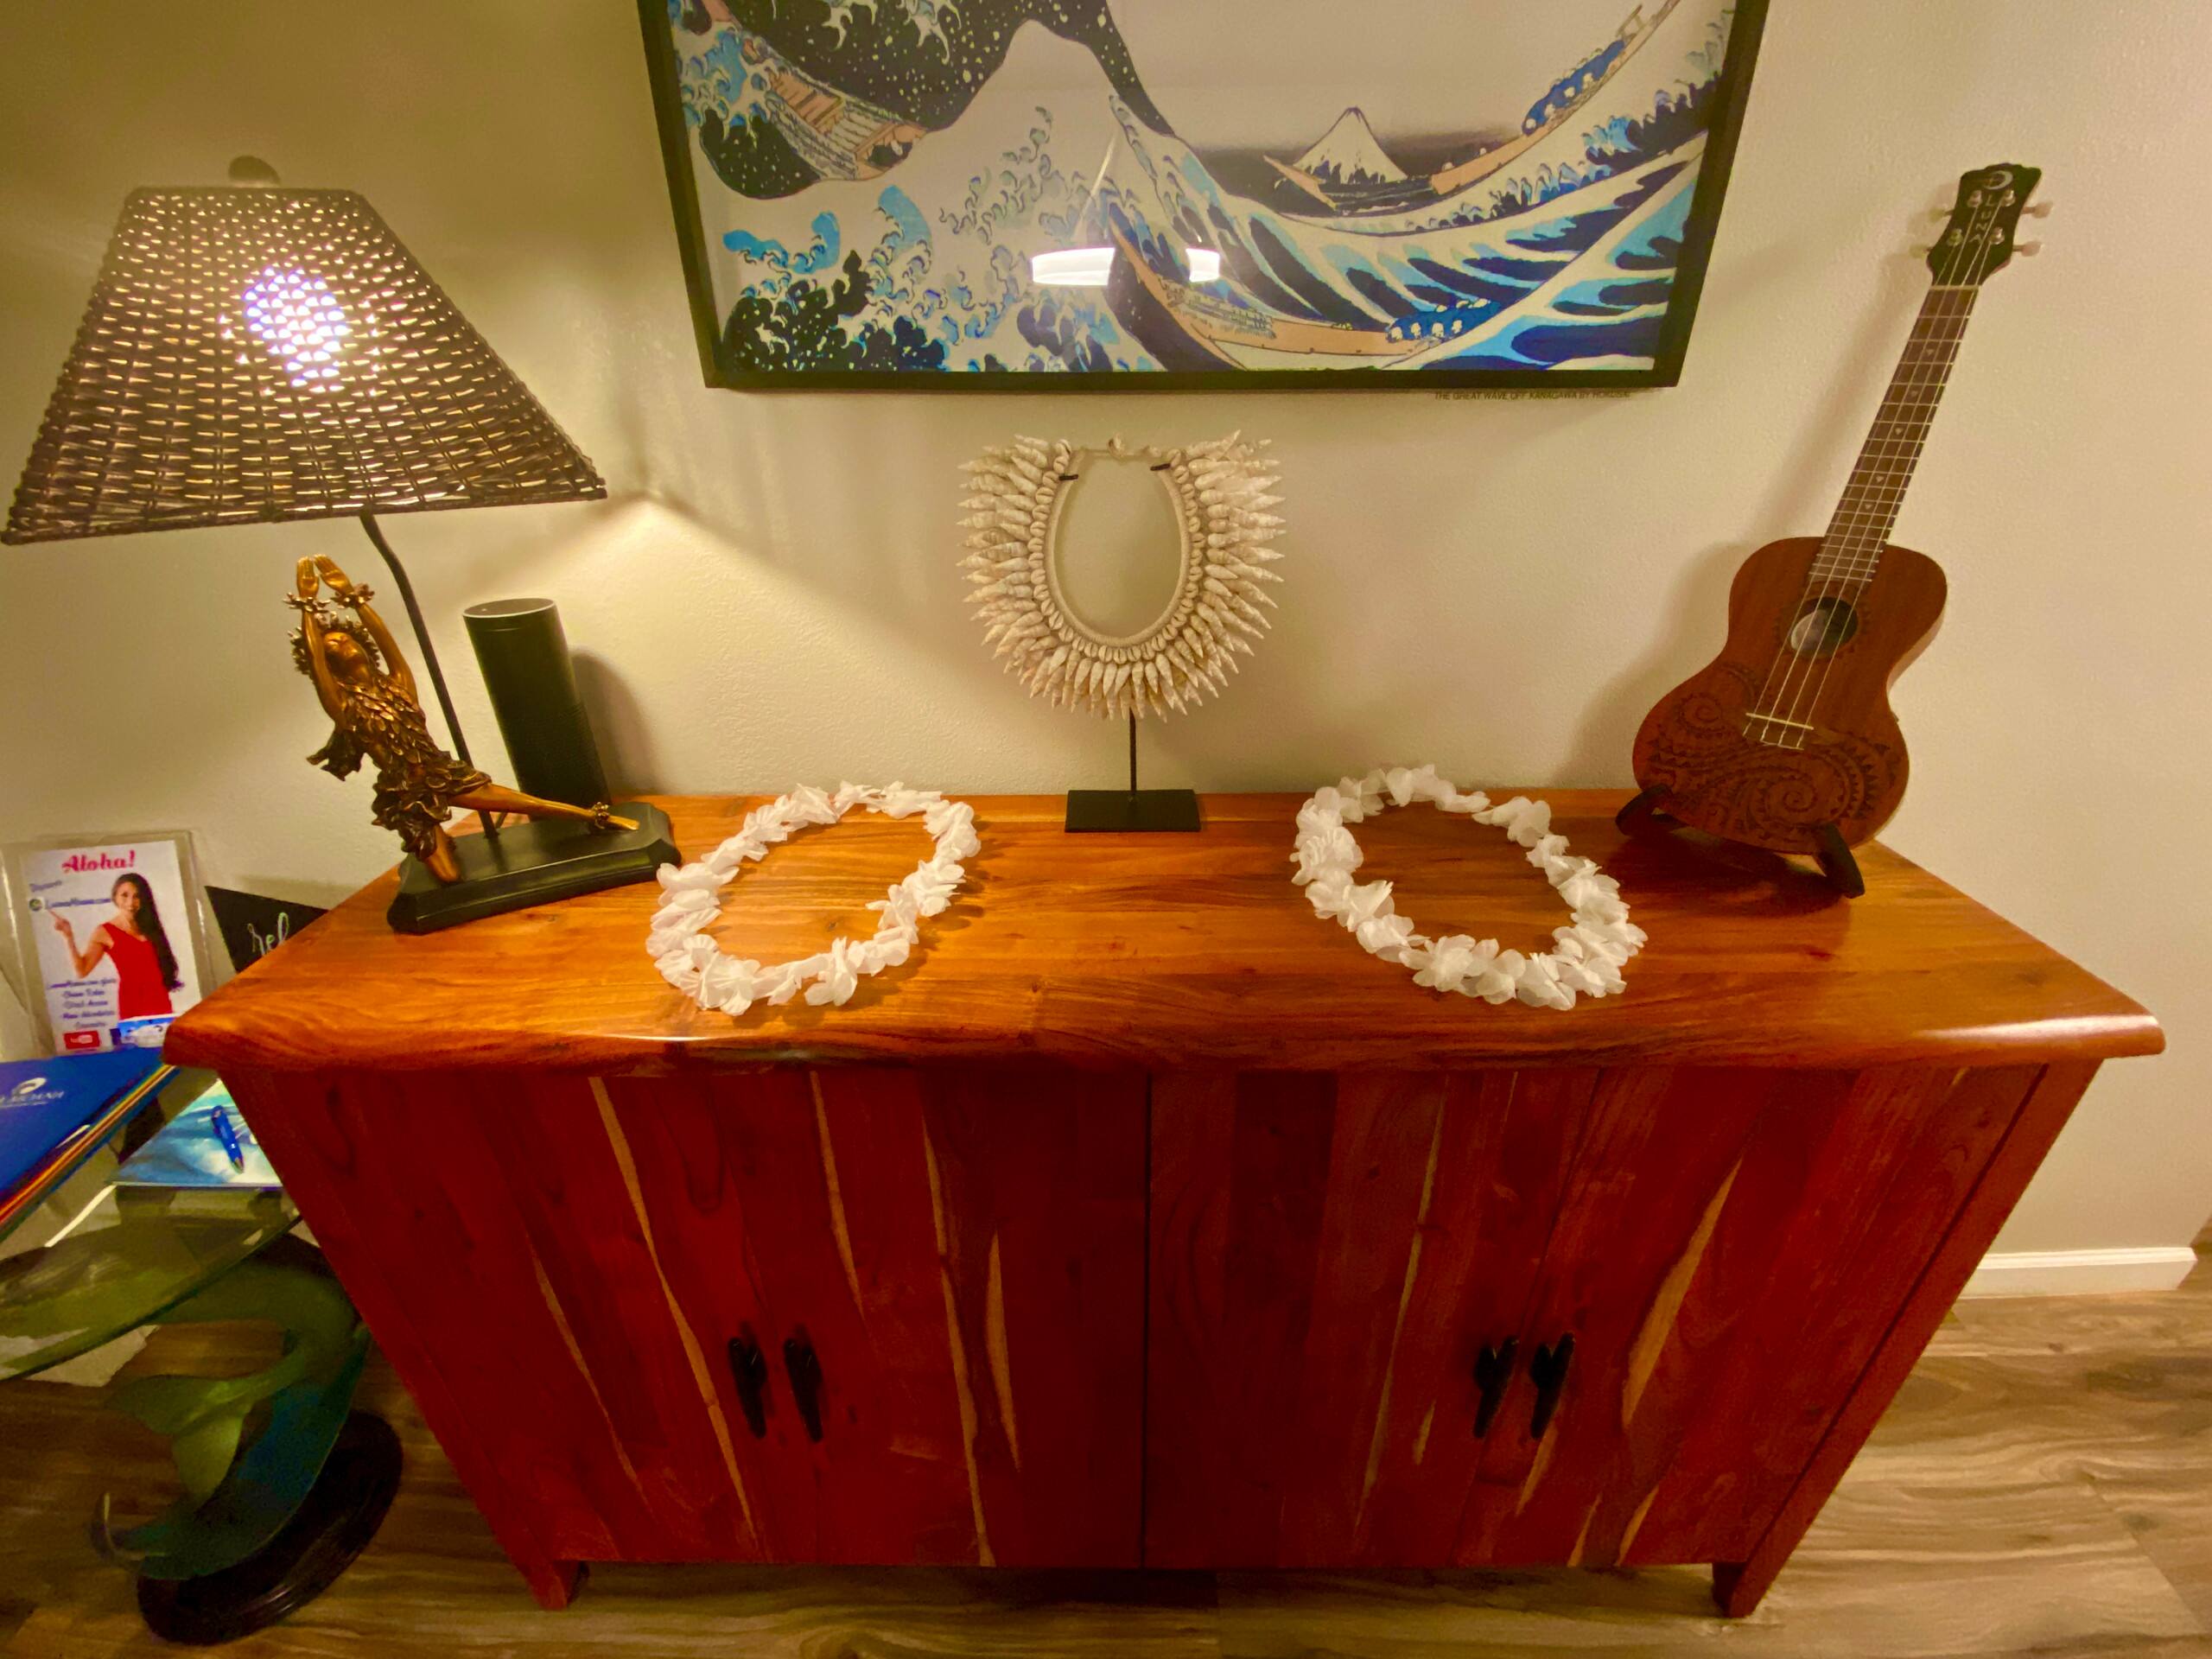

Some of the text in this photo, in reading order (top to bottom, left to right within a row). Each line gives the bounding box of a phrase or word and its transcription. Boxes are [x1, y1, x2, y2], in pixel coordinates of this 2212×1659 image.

[1968, 195, 1995, 244] LUNA
[1434, 392, 1451, 401] THE
[1452, 392, 1482, 401] GREAT
[1484, 391, 1508, 401] WAVE
[62, 849, 136, 873] Aloha!
